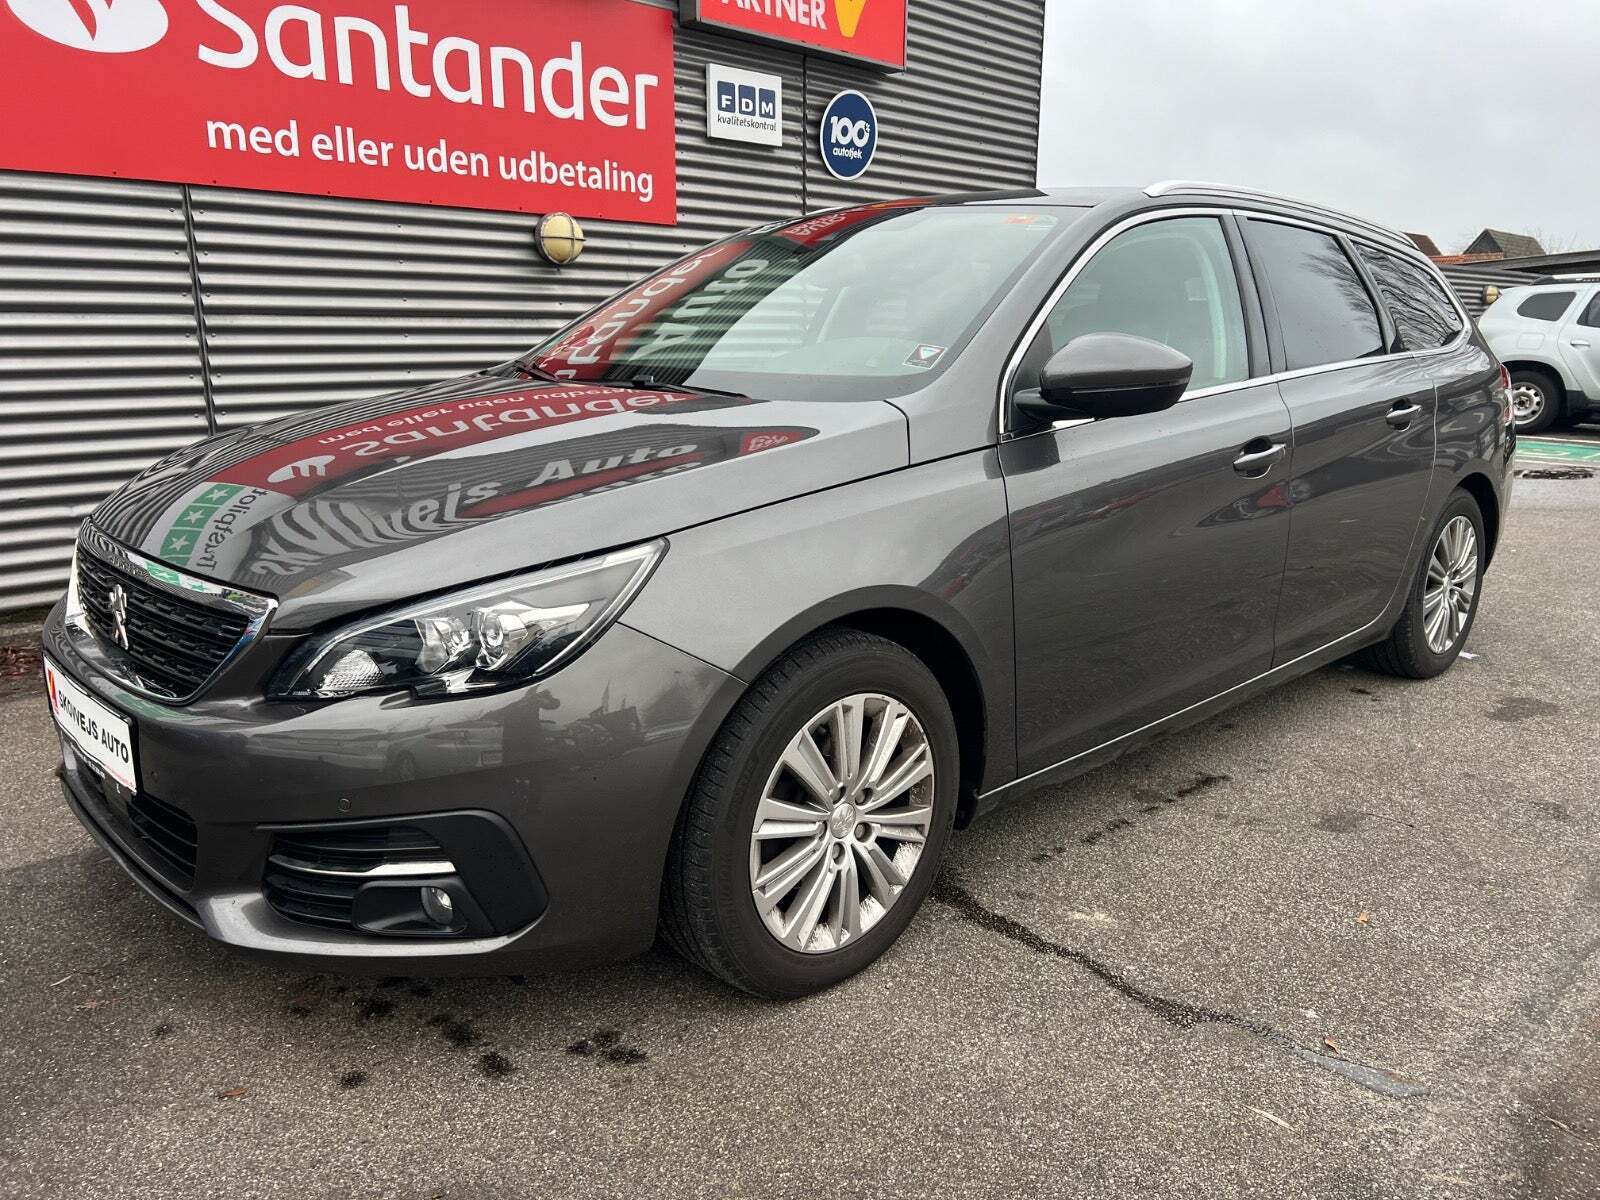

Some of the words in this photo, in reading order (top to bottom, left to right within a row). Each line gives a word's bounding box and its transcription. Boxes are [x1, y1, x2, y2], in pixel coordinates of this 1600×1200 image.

[197, 0, 659, 130] Santander
[717, 113, 777, 132] kvalitetskontrol
[721, 94, 774, 116] FDM
[206, 119, 300, 157] med
[311, 125, 394, 167] eller
[403, 138, 490, 178] uden
[498, 150, 654, 203] udbetaling
[101, 727, 129, 764] AUTO
